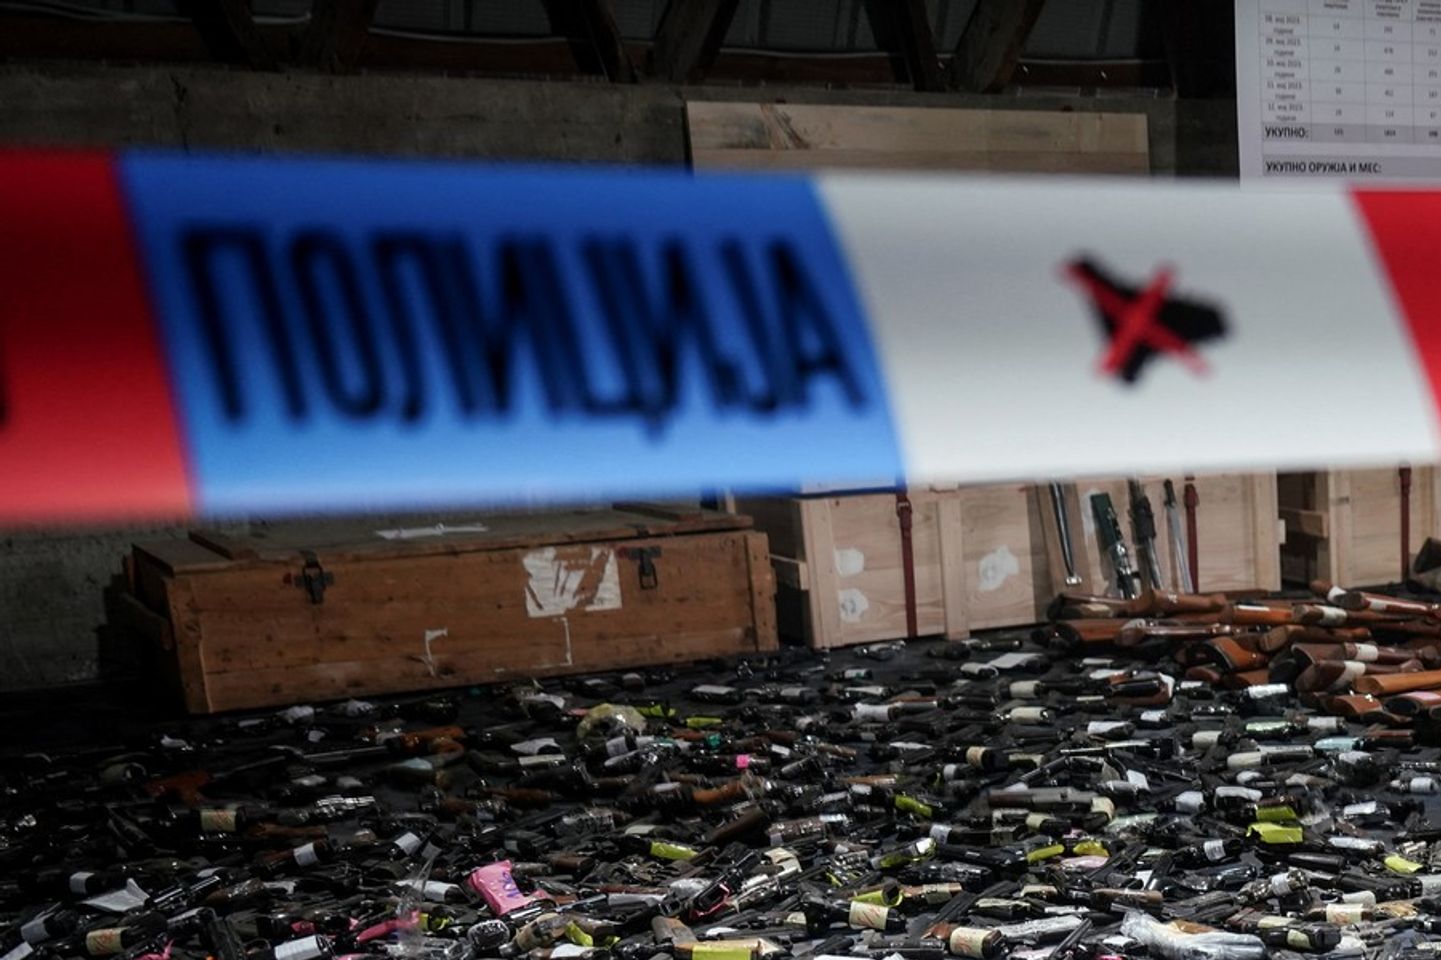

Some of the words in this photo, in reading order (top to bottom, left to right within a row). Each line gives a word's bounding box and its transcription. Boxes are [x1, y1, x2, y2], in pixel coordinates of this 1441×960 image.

[1265, 126, 1309, 138] УКУПНО:
[1266, 161, 1307, 173] УКУПНО
[1308, 162, 1347, 173] ОРУЖЈА
[1349, 162, 1356, 173] И
[1358, 163, 1382, 173] МЕС:
[180, 224, 870, 443] ПОЛИЦИЈА
